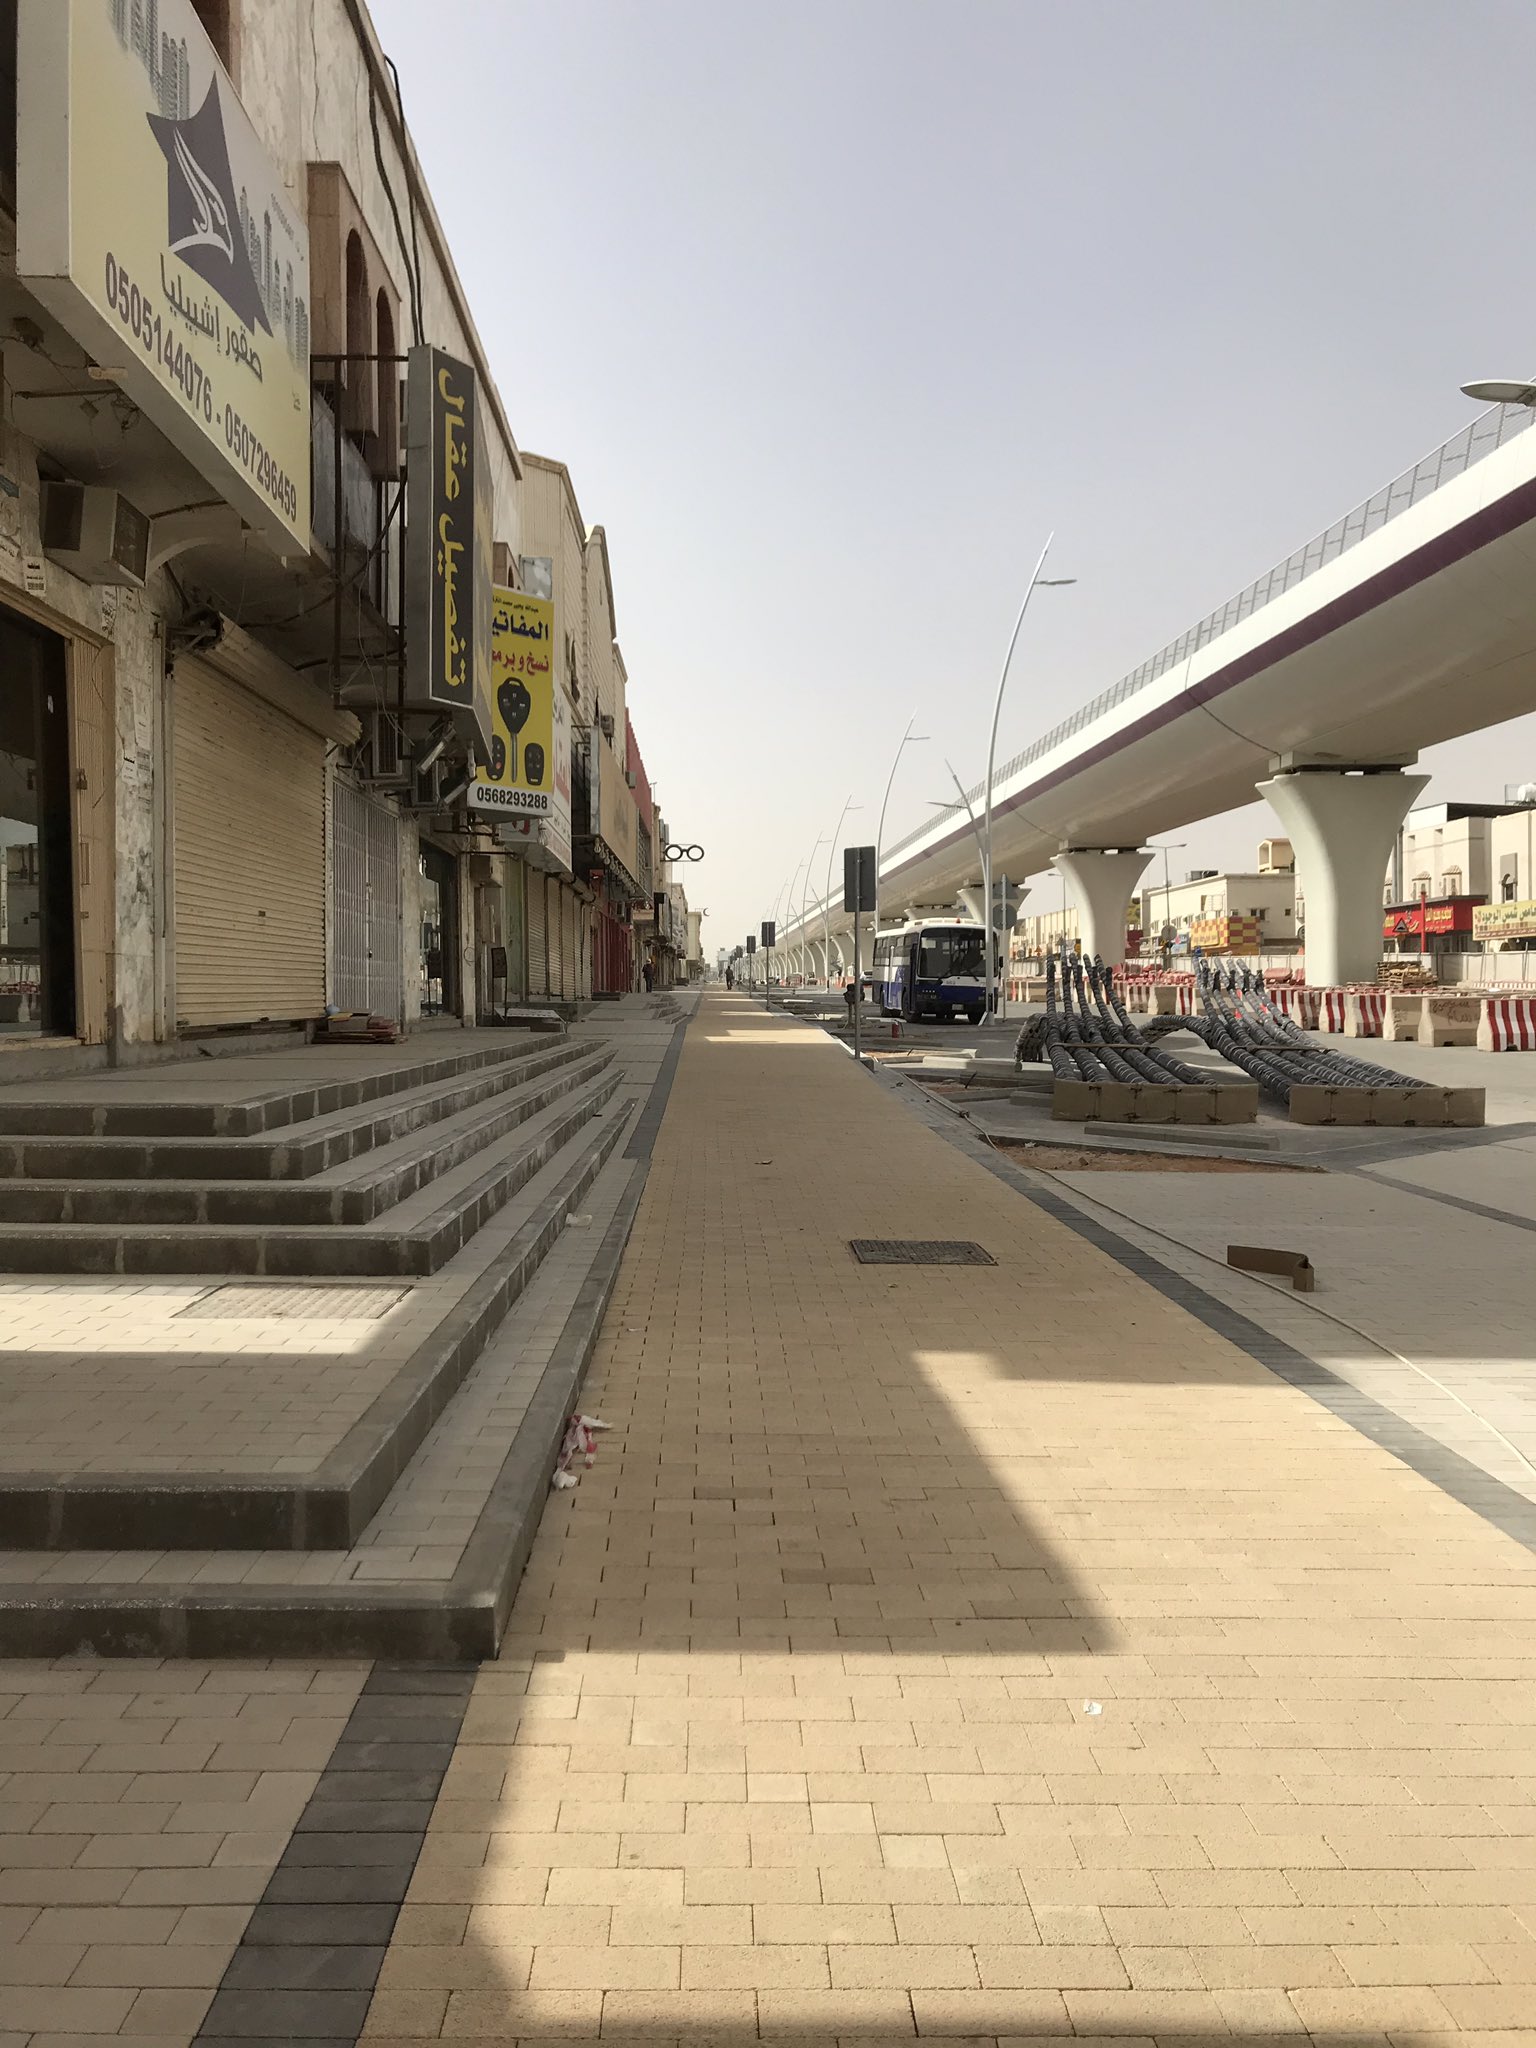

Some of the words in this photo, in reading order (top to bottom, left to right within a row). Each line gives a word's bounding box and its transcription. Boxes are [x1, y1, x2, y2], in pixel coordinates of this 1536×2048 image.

[160, 252, 221, 352] إشبيليا
[105, 252, 212, 424] 0505144076
[225, 403, 297, 522] 0507296459
[226, 325, 263, 383] صقور
[438, 368, 466, 501] عقال
[437, 513, 466, 687] تفصيل
[518, 655, 525, 671] و
[527, 651, 549, 676] نسخ
[476, 786, 548, 810] 0568293288
